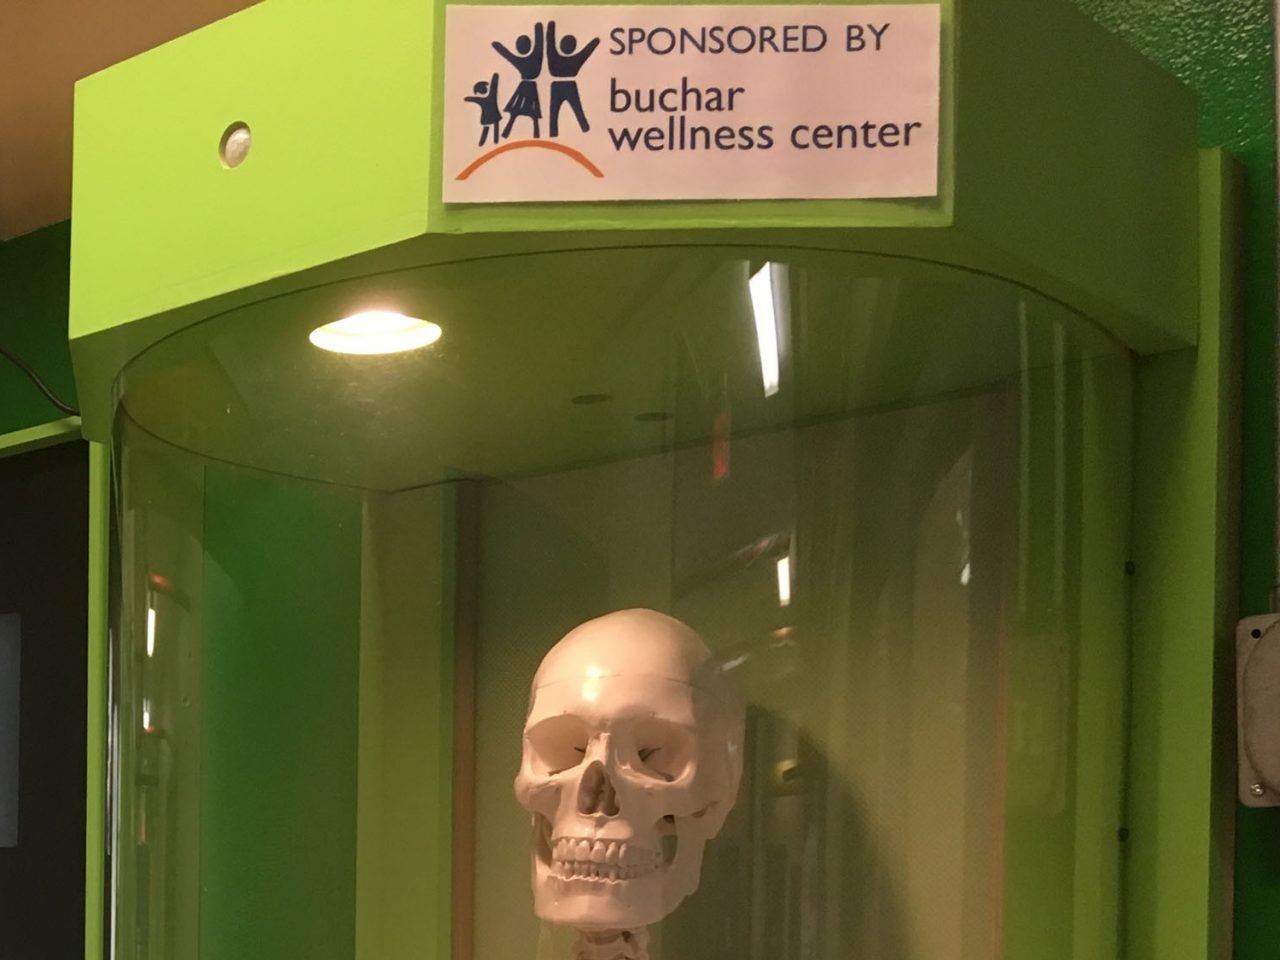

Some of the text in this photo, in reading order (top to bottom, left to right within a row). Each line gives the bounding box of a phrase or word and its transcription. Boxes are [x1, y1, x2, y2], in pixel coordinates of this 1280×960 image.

[609, 23, 890, 56] SPONSORED BY
[609, 77, 744, 113] buchar
[608, 115, 922, 152] wellness center
